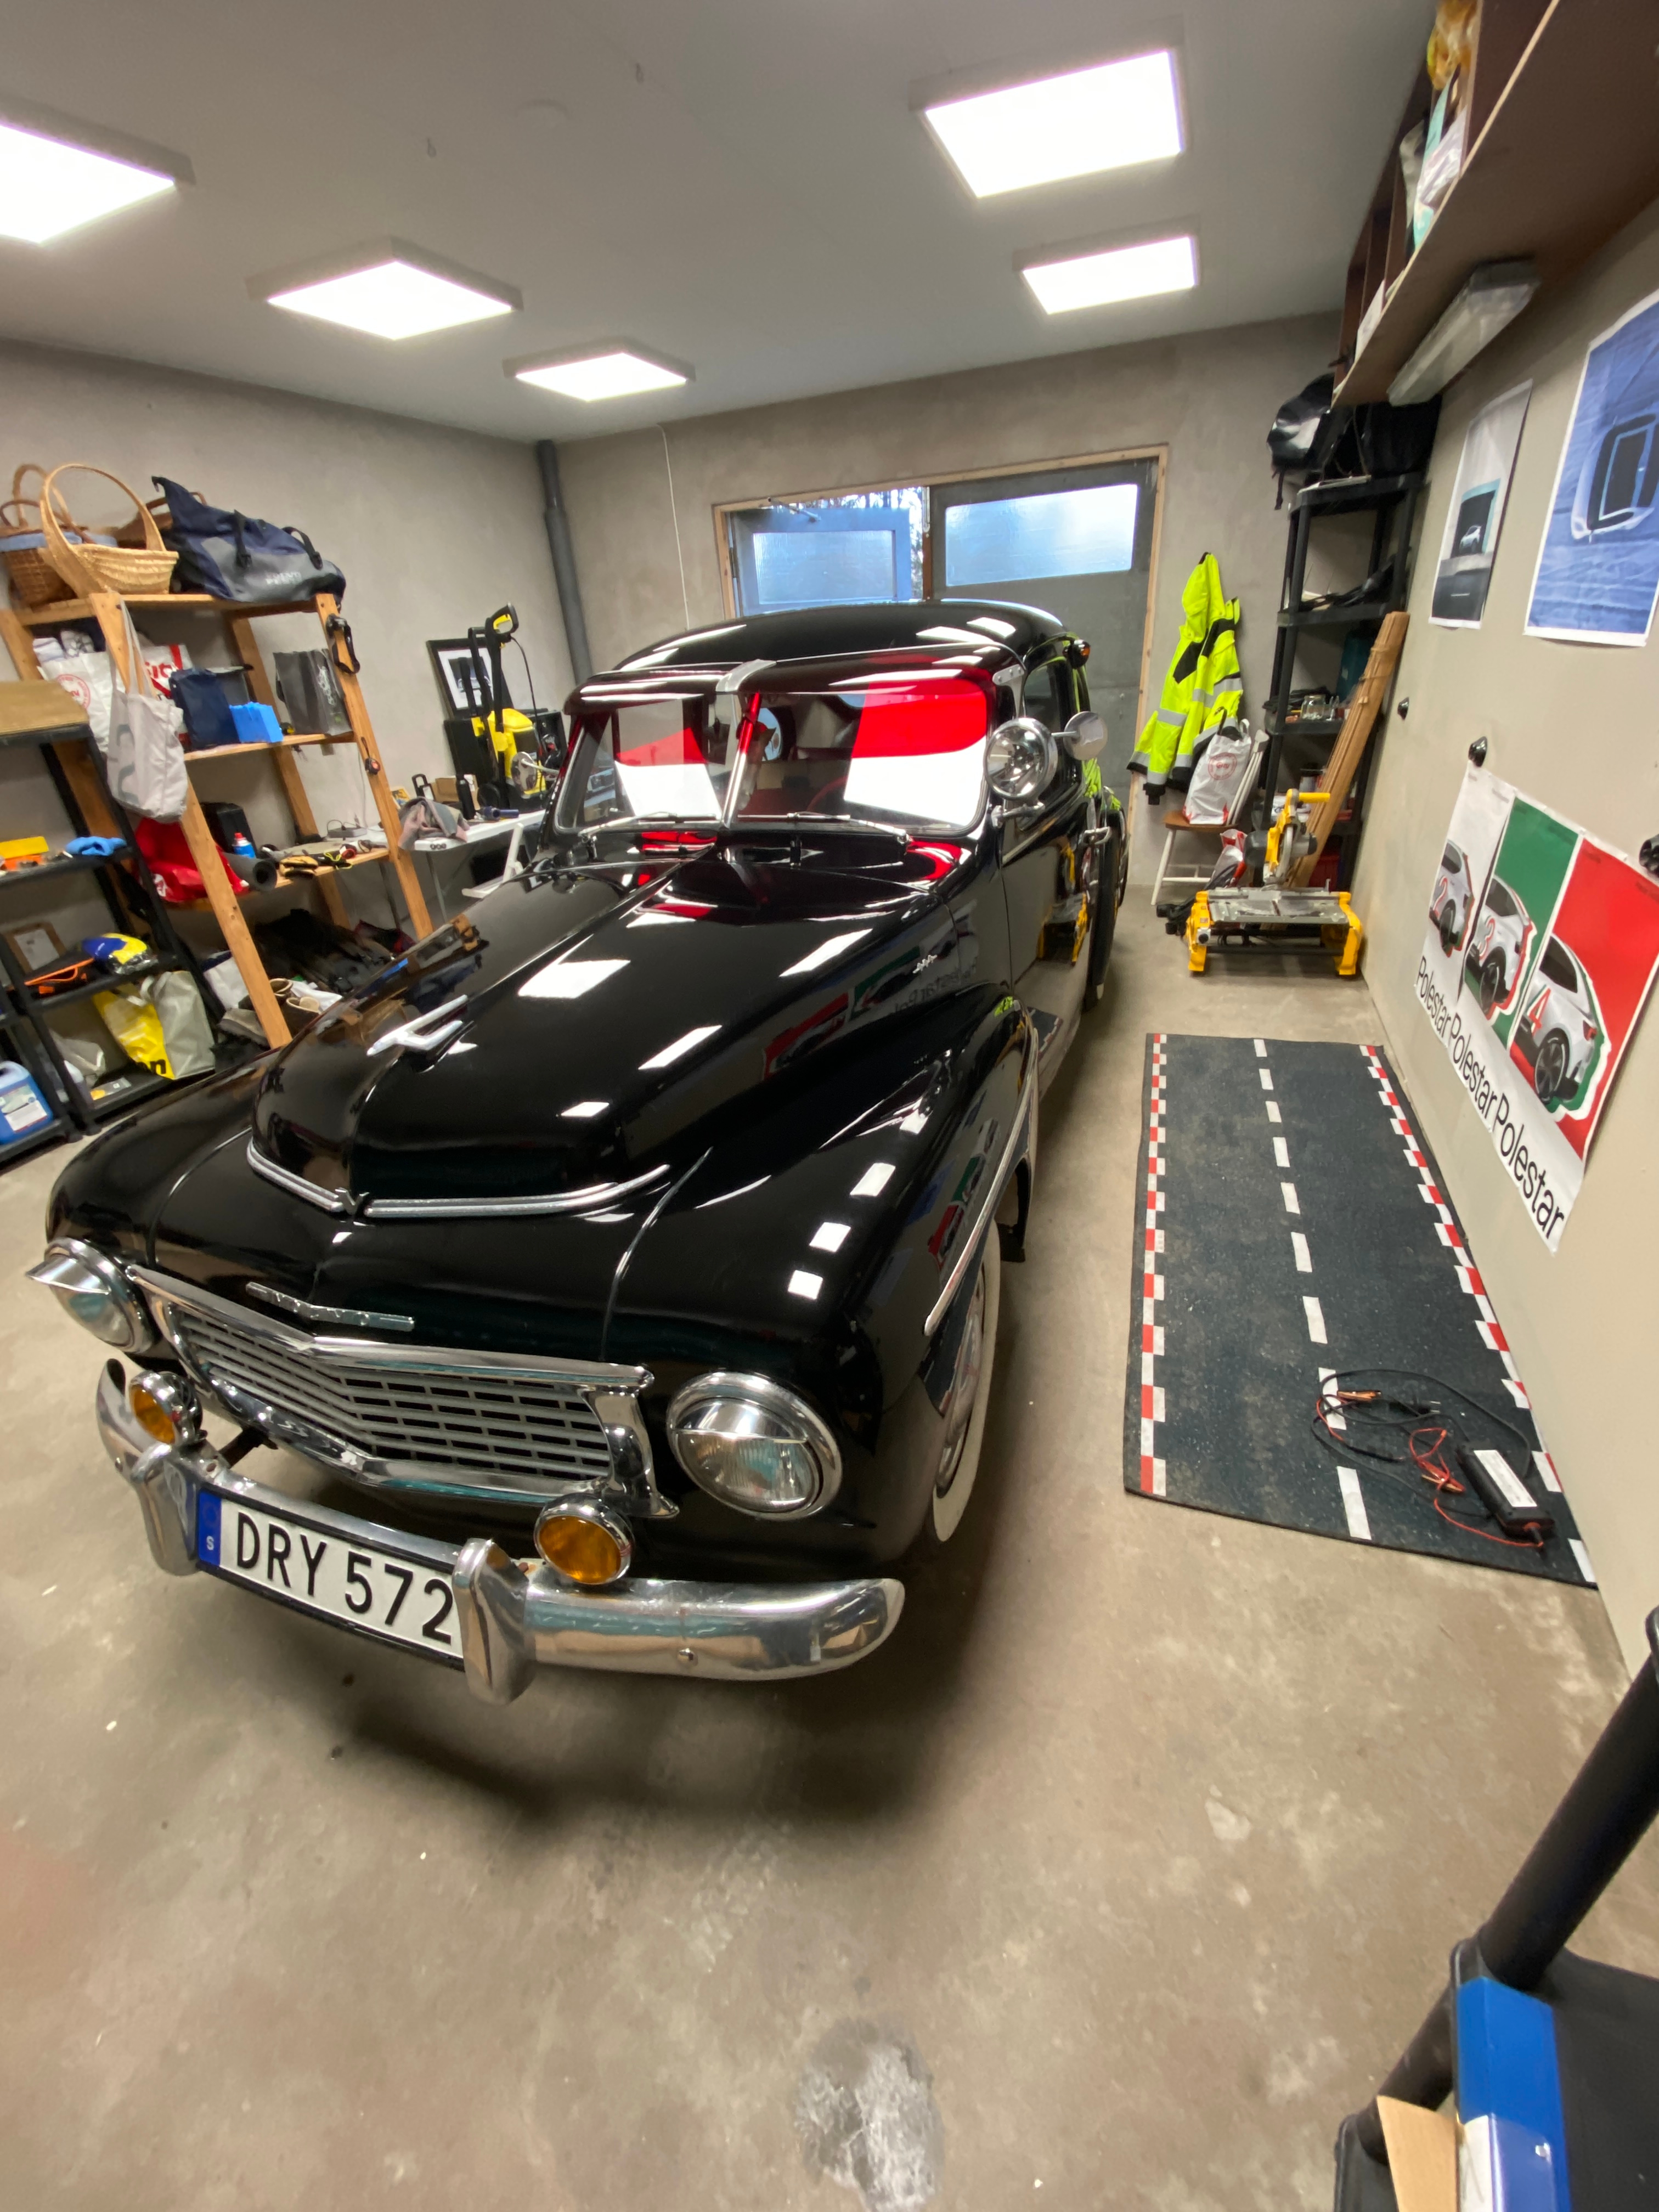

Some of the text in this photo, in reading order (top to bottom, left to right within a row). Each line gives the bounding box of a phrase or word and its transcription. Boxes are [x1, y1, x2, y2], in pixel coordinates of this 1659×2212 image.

[1527, 986, 1551, 1037] 4
[1416, 955, 1565, 1239] Polestar Polestar Polestar
[206, 1536, 215, 1551] S
[237, 1511, 454, 1645] DRY 572
